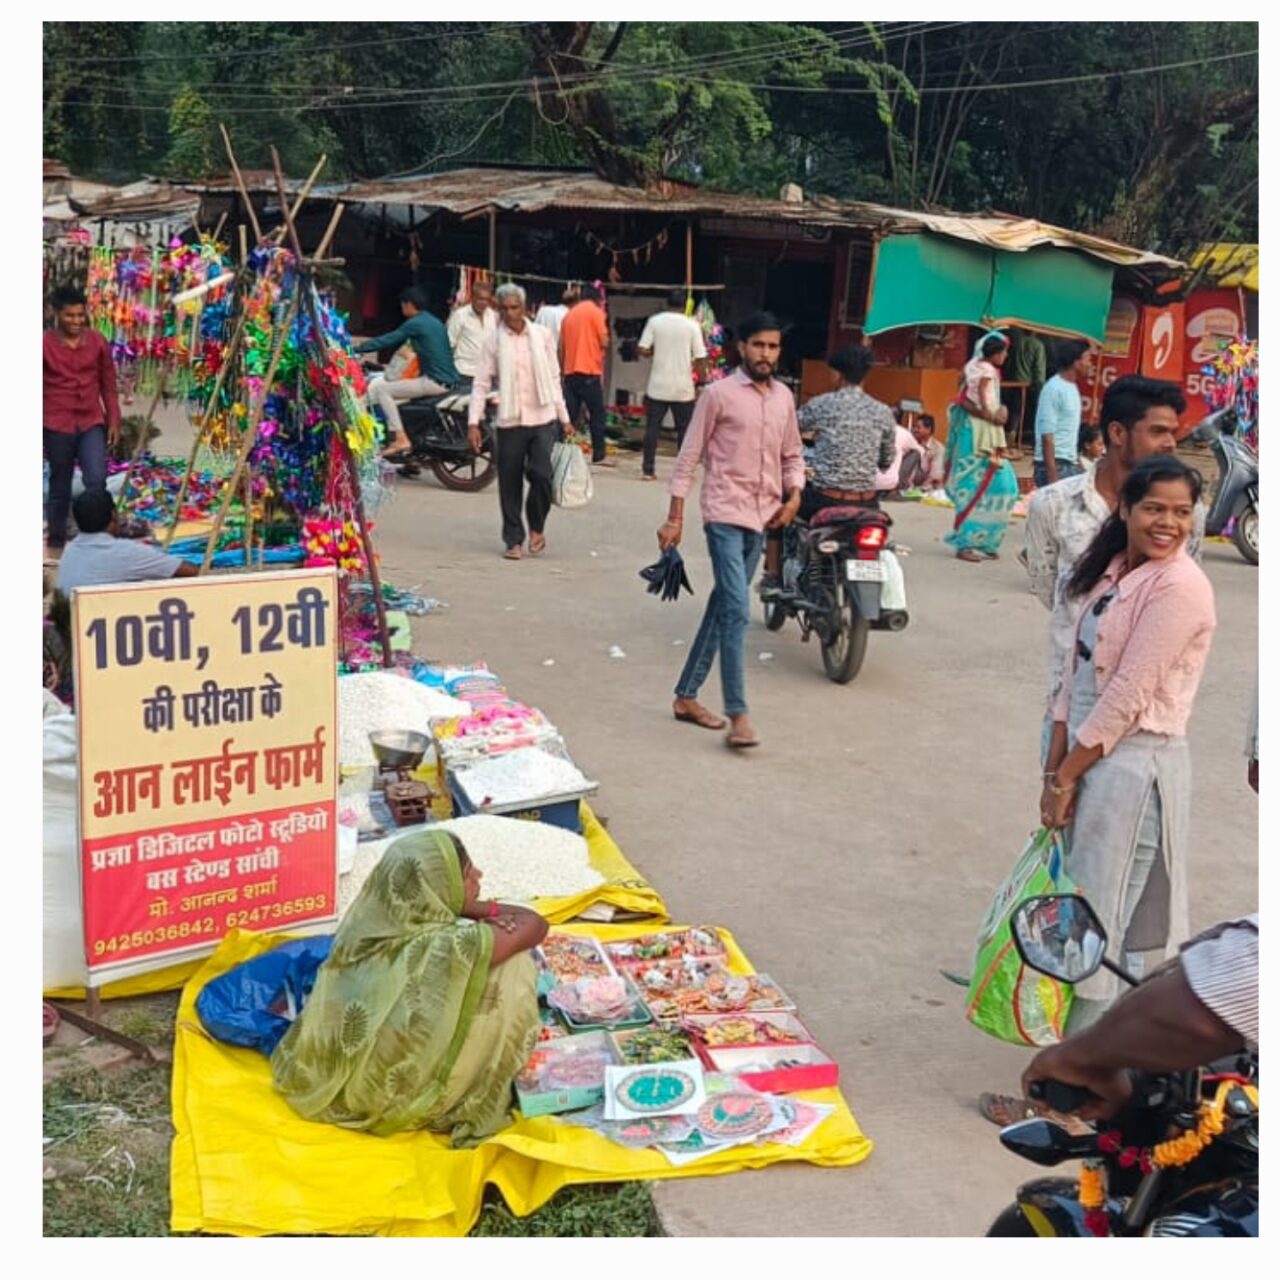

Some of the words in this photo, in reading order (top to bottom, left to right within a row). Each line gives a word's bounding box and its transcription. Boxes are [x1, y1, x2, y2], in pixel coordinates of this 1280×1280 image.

[86, 597, 210, 670] 10वी,
[231, 587, 330, 655] 12वी
[142, 685, 176, 734] की
[182, 679, 256, 728] परीक्षा
[259, 672, 283, 719] के
[93, 763, 164, 818] आन
[171, 737, 258, 806] लाईन
[264, 725, 326, 790] फार्म
[137, 829, 217, 862] डिजिटल
[219, 819, 264, 847] फोटो
[180, 887, 238, 913] आनन्द
[243, 875, 279, 899] शर्मा
[225, 894, 327, 928] 624736593
